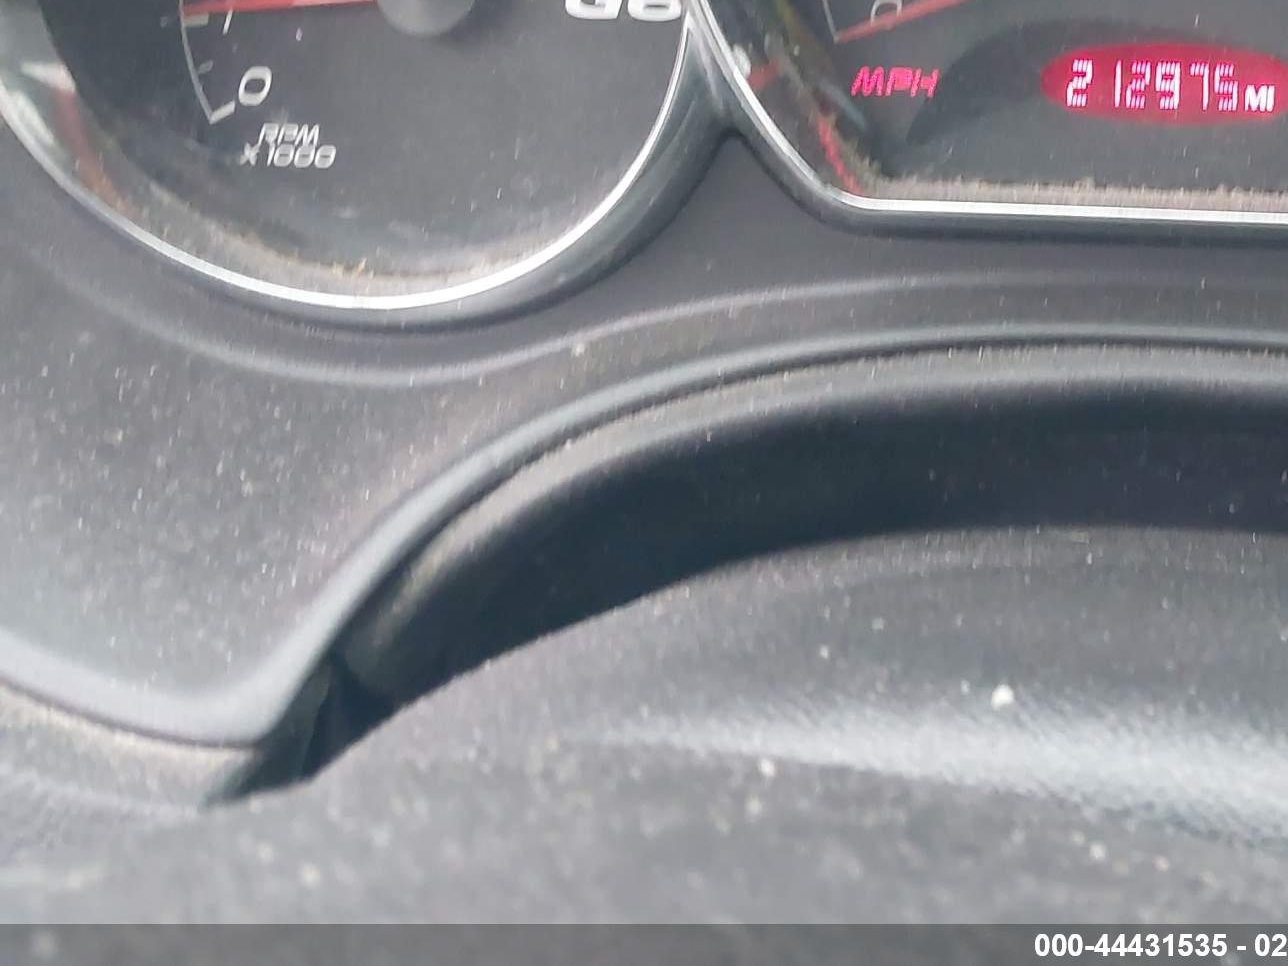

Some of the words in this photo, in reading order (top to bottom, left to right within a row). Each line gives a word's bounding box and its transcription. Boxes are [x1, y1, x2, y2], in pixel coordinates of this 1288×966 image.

[238, 66, 272, 106] 0
[851, 65, 940, 99] MPH
[1066, 58, 1239, 112] 212975
[258, 123, 320, 145] RPM
